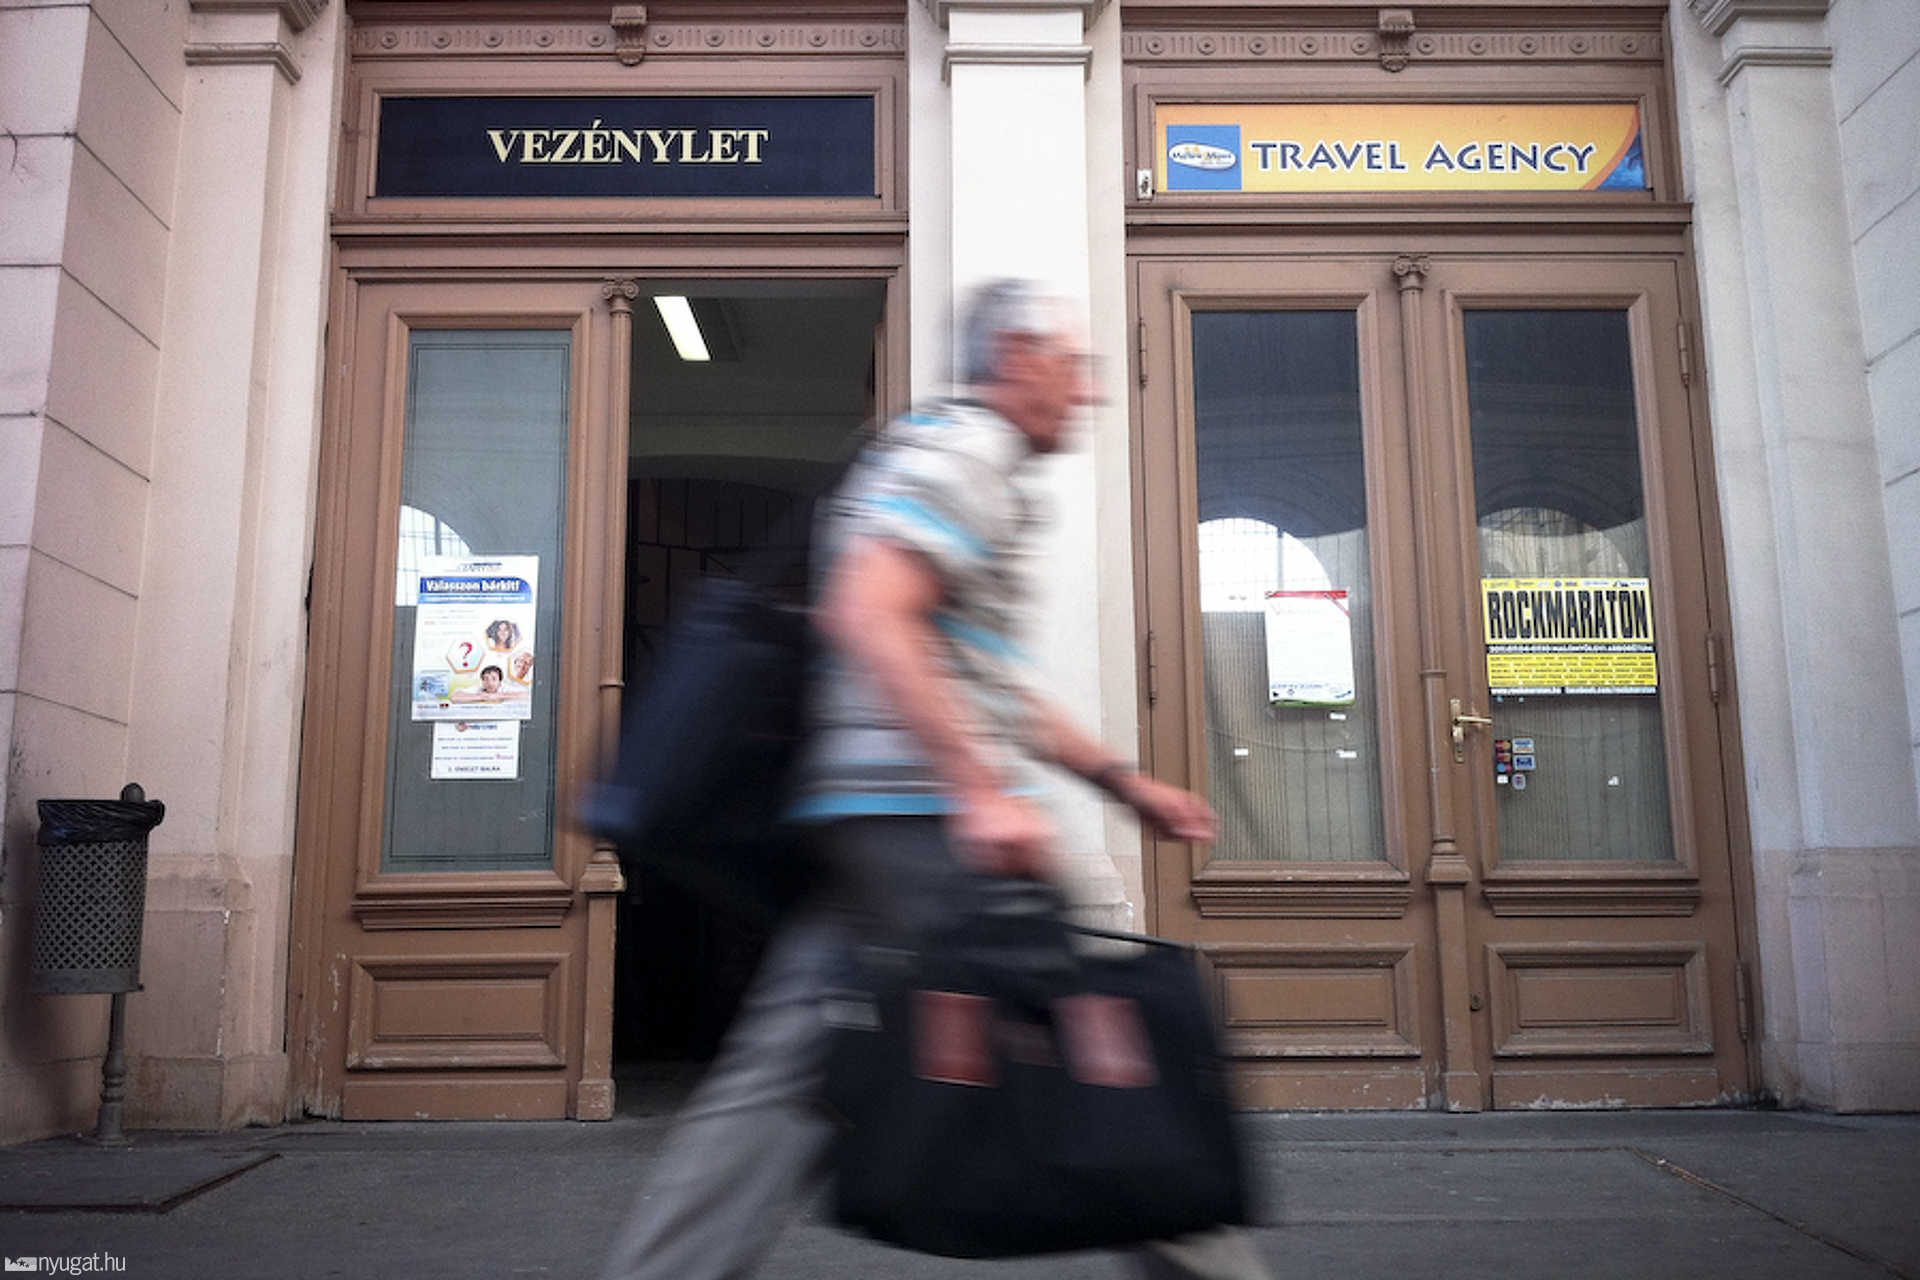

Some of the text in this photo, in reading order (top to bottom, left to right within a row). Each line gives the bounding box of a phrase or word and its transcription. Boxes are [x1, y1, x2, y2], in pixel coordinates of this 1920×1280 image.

[487, 119, 769, 163] VEZÉNYLET
[1250, 142, 1596, 172] TRAVEL AGENCY
[1486, 590, 1649, 639] ROCKMARATON
